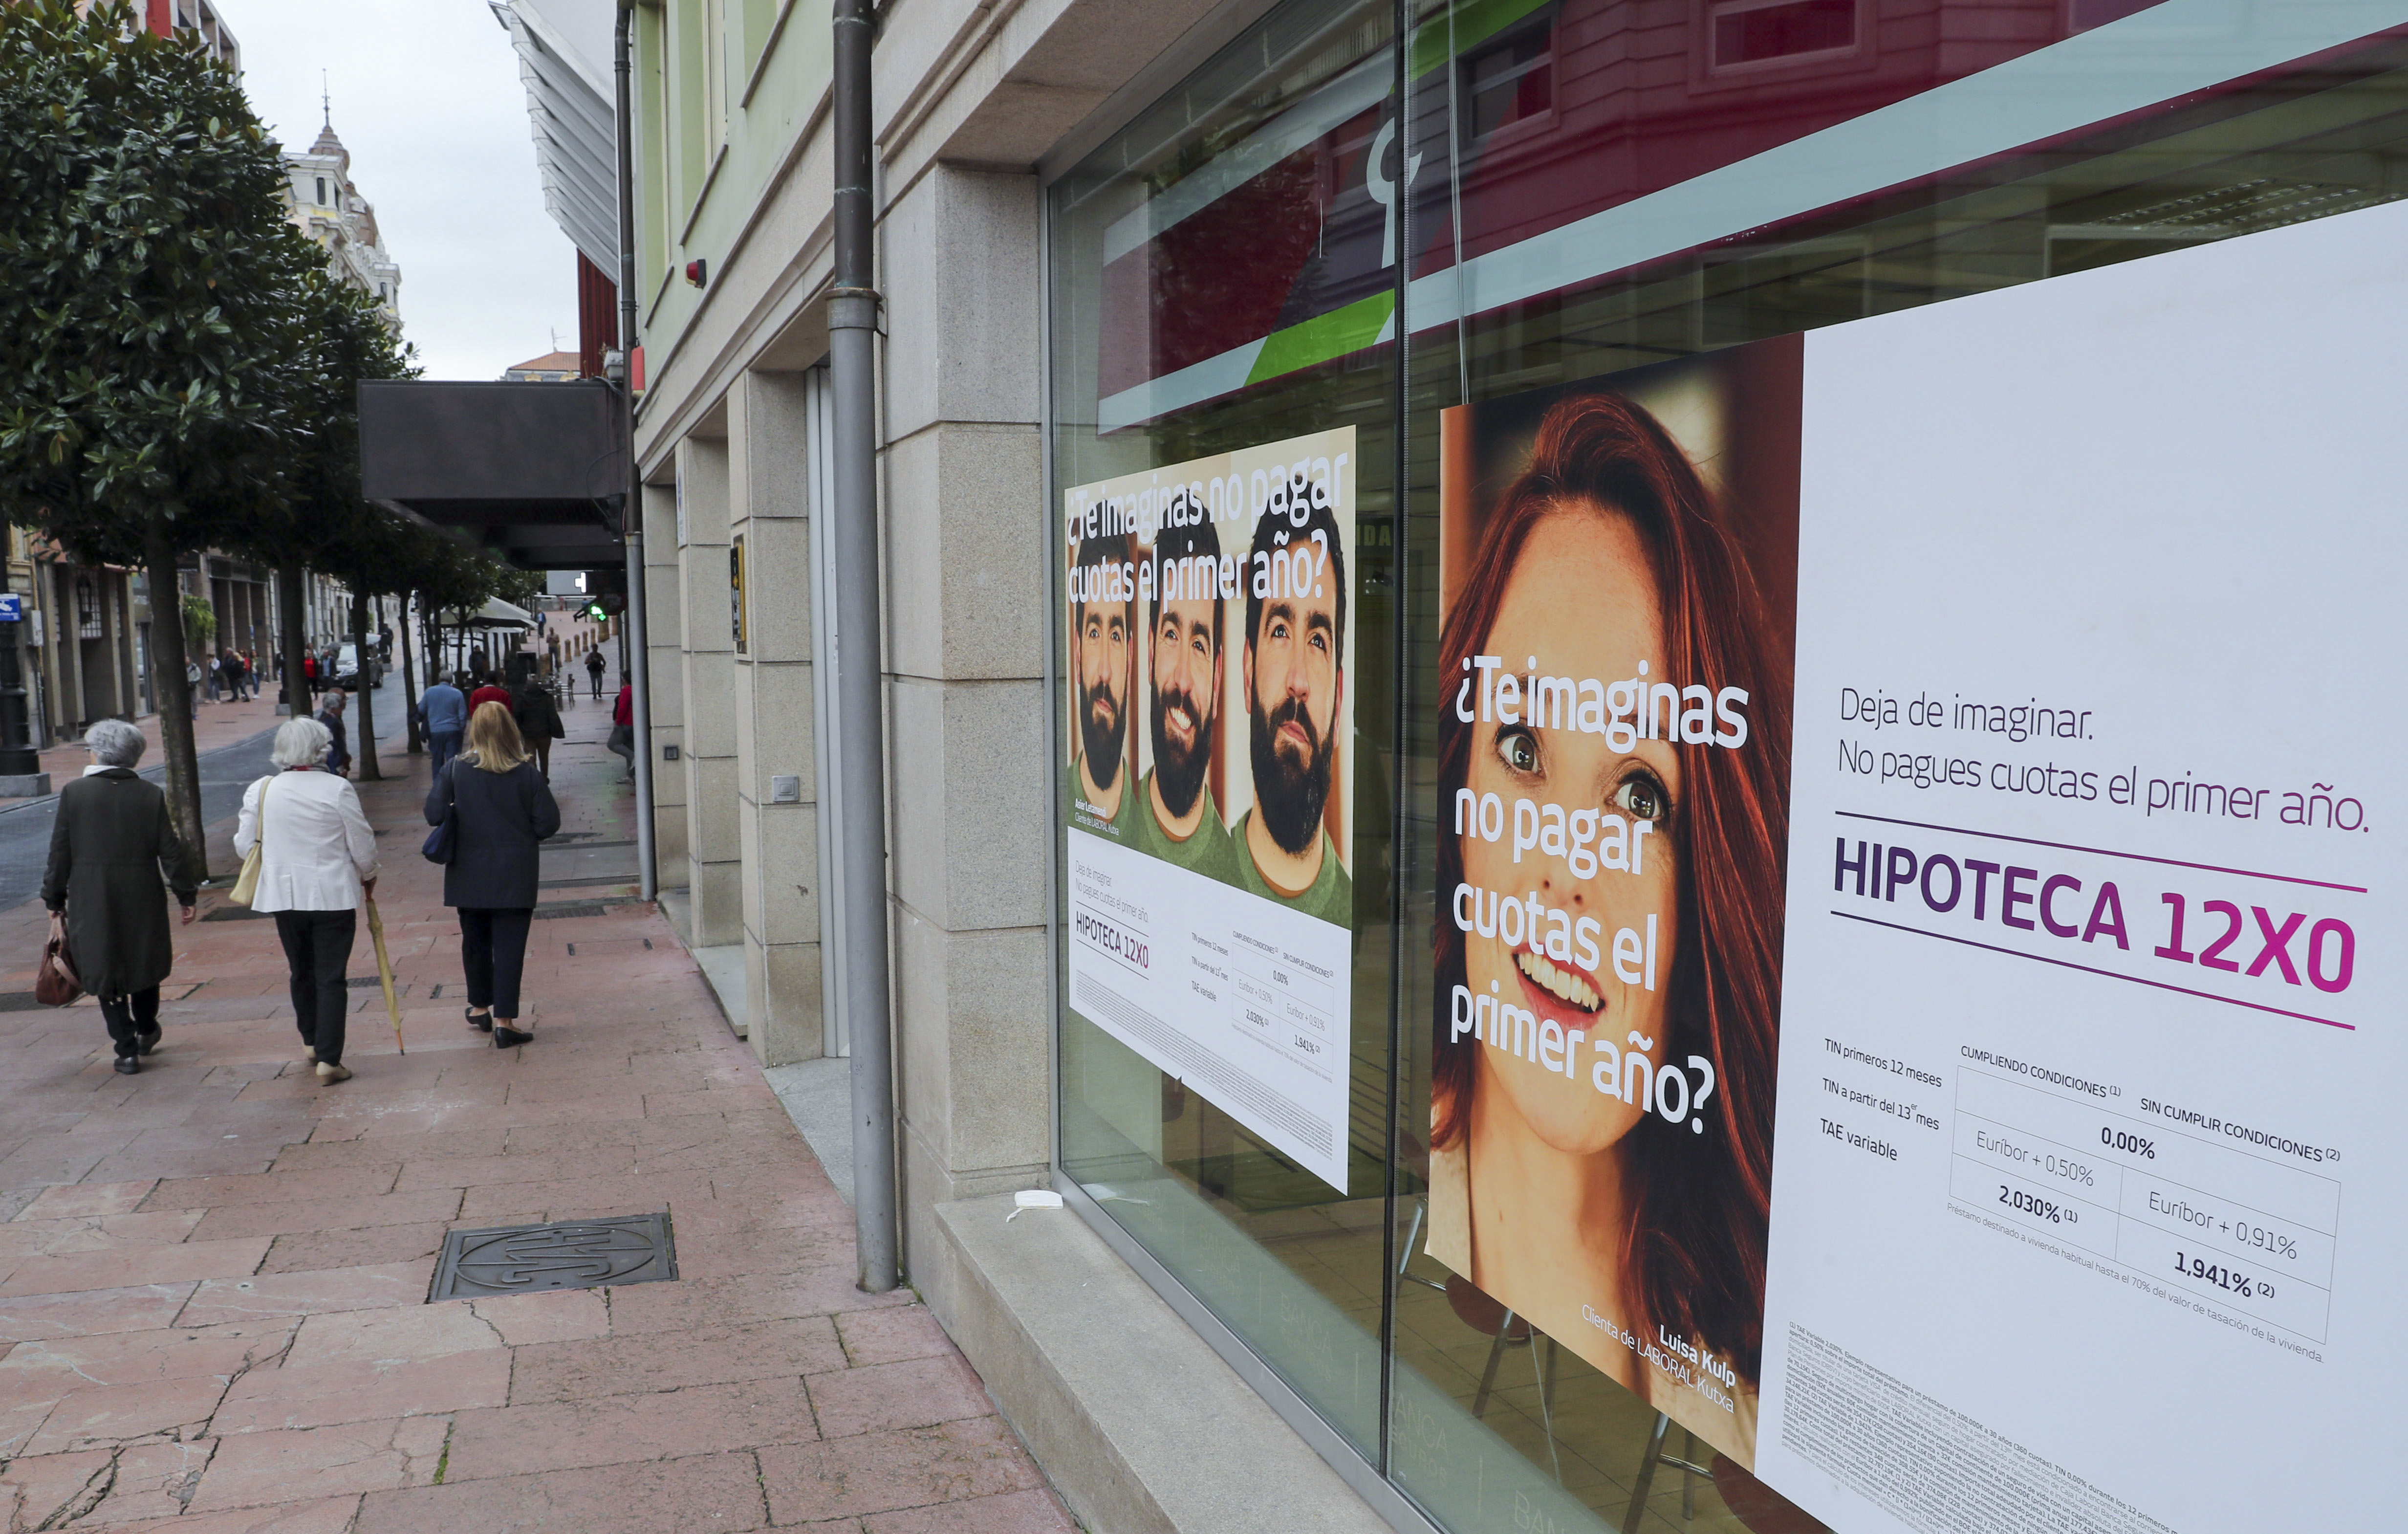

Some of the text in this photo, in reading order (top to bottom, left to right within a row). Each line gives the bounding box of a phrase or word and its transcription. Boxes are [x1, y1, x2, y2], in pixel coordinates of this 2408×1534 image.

[1067, 452, 1347, 546] ¿Te imaginas no pagar
[1068, 528, 1328, 614] cuotas el primer año?
[1456, 655, 1748, 754] ¿Te imaginas
[1841, 688, 2093, 742] Deja de imaginar.
[1839, 739, 2368, 833] No pagues cuotas el primer año.
[1456, 788, 1652, 879] no pagar
[1075, 860, 1085, 877] Deja
[1086, 865, 1092, 878] de
[1076, 878, 1082, 890] No
[1083, 883, 1099, 899] pagues
[1100, 891, 1116, 907] cuotas
[1116, 897, 1121, 910] el
[1122, 900, 1137, 917] primer
[1077, 911, 1149, 969] HIPOTECA 12X0
[1453, 882, 1657, 991] cuotas el
[1835, 837, 2355, 994] HIPOTECA 12X0
[1200, 987, 1216, 1002] variable
[1273, 970, 1288, 986] 0,00%
[1246, 1008, 1264, 1027] 2,030%
[1295, 1034, 1315, 1054] 1,941%
[1451, 979, 1585, 1079] primer
[1592, 1030, 1715, 1135] año?
[1824, 1038, 1942, 1088] TIN primeros 12 meses
[1960, 1045, 2121, 1098] CUMPLIENDO CONDICIONES (1)
[1822, 1077, 1839, 1095] TIN
[1841, 1087, 1847, 1098] a
[1849, 1090, 1877, 1108] partir
[1880, 1098, 1895, 1115] del
[1916, 1114, 1940, 1130] mes
[2140, 1097, 2341, 1162] SIN CUMPLIR CONDICIONES (2)
[1820, 1118, 1898, 1161] TAE variable
[1976, 1130, 2094, 1187] Euríbor + 0,50%
[2101, 1127, 2155, 1160] 0,00%
[1999, 1185, 2078, 1224] 2,030% (1)
[2149, 1191, 2298, 1260] Euríbor + 0,91%
[1947, 1203, 1981, 1223] Préstamo
[1983, 1217, 2019, 1239] destinado
[2028, 1236, 2059, 1255] vivienda
[2061, 1248, 2093, 1270] habitual
[2095, 1261, 2120, 1279] hasta
[2121, 1274, 2129, 1284] el
[2131, 1277, 2151, 1293] 70%
[2152, 1286, 2166, 1299] del
[2168, 1292, 2191, 1309] valor
[2193, 1302, 2205, 1315] de
[2207, 1308, 2249, 1333] tasación
[2252, 1326, 2264, 1339] de
[2267, 1332, 2276, 1344] la
[2278, 1337, 2324, 1364] vivienda.
[2174, 1251, 2275, 1299] 1,941% (2)
[1281, 1292, 1332, 1361] BANCA
[1660, 1324, 1736, 1388] Luisa Kulp
[1582, 1304, 1734, 1414] Clienta de LABORAL Kutxa
[1395, 1393, 1449, 1462] ANCA
[1797, 1324, 1806, 1334] TAE
[1806, 1330, 1825, 1345] Variable
[1844, 1351, 1864, 1366] Ejemplo
[1865, 1363, 1901, 1386] representativo
[1902, 1381, 1914, 1394] para
[1915, 1390, 1922, 1398] un
[1922, 1394, 1948, 1412] préstamo
[1949, 1408, 1956, 1417] de
[1957, 1412, 1983, 1432] 100.000€
[1990, 1429, 1997, 1439] 30
[1998, 1436, 2013, 1447] años
[2014, 1443, 2027, 1455] (360
[2055, 1465, 2066, 1476] TIN
[2088, 1484, 2115, 1503] durante
[2116, 1498, 2126, 1509] los
[2128, 1505, 2136, 1515] 12
[2138, 1511, 2170, 1533] primeros
